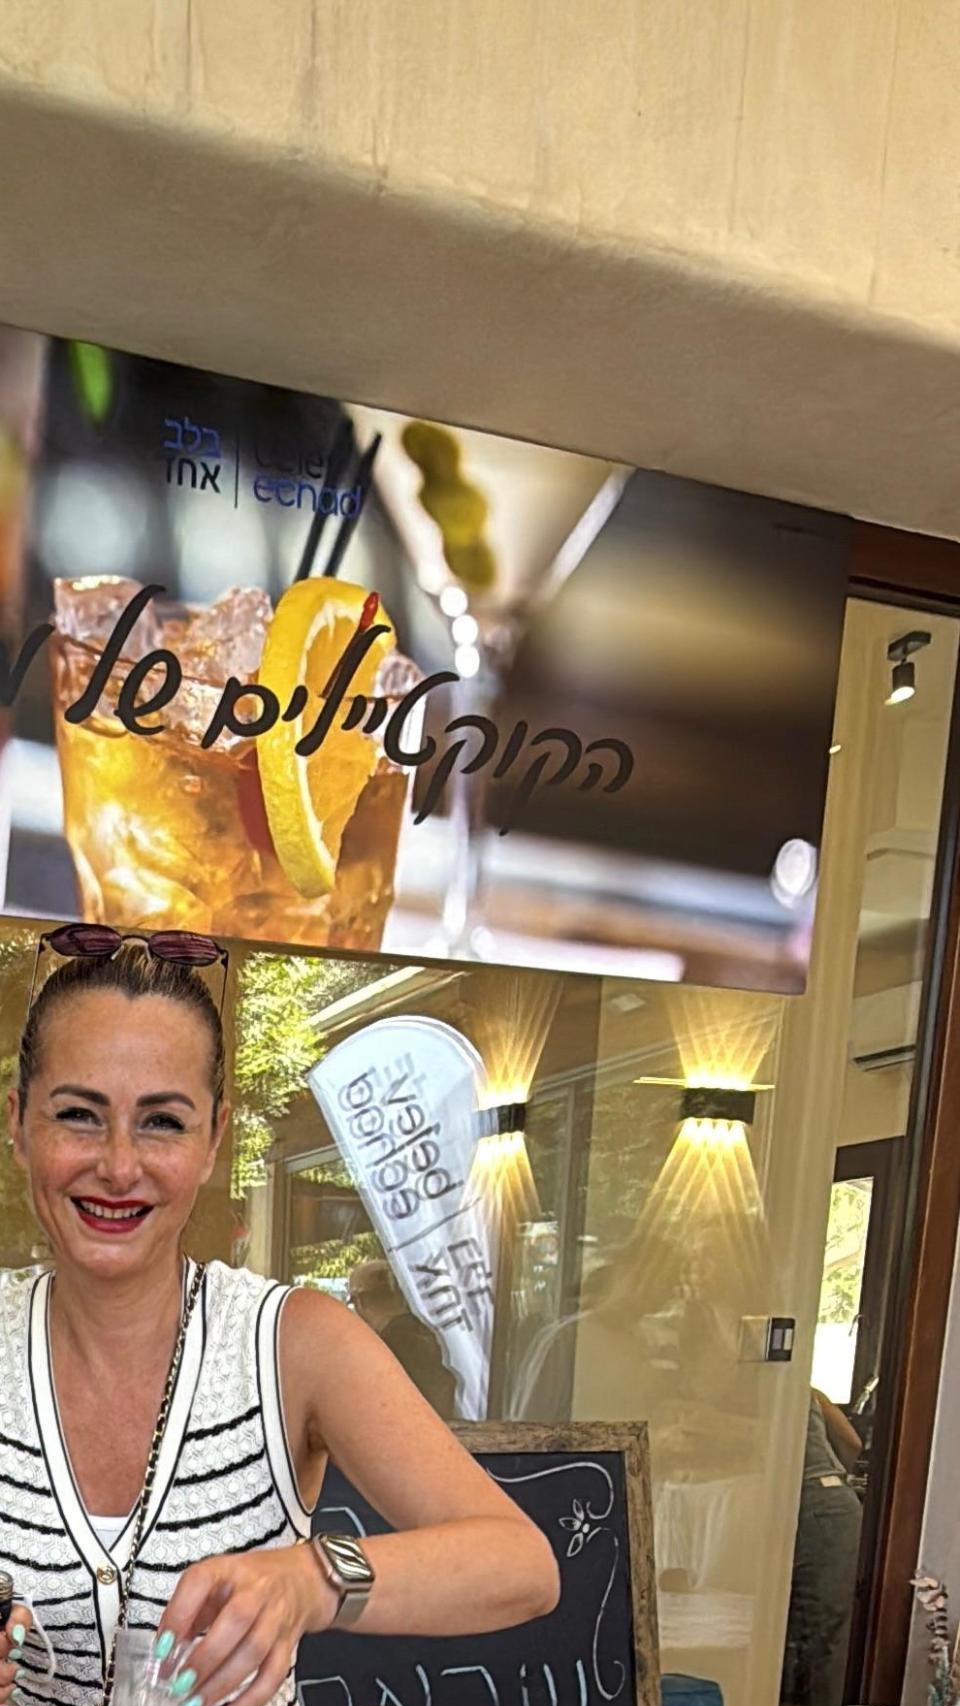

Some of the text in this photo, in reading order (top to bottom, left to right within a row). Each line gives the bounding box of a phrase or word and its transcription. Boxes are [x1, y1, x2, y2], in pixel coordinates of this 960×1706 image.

[164, 416, 224, 460] בלב
[164, 455, 222, 494] אחד
[64, 584, 183, 736] של
[200, 622, 636, 836] הקוקטיילים
